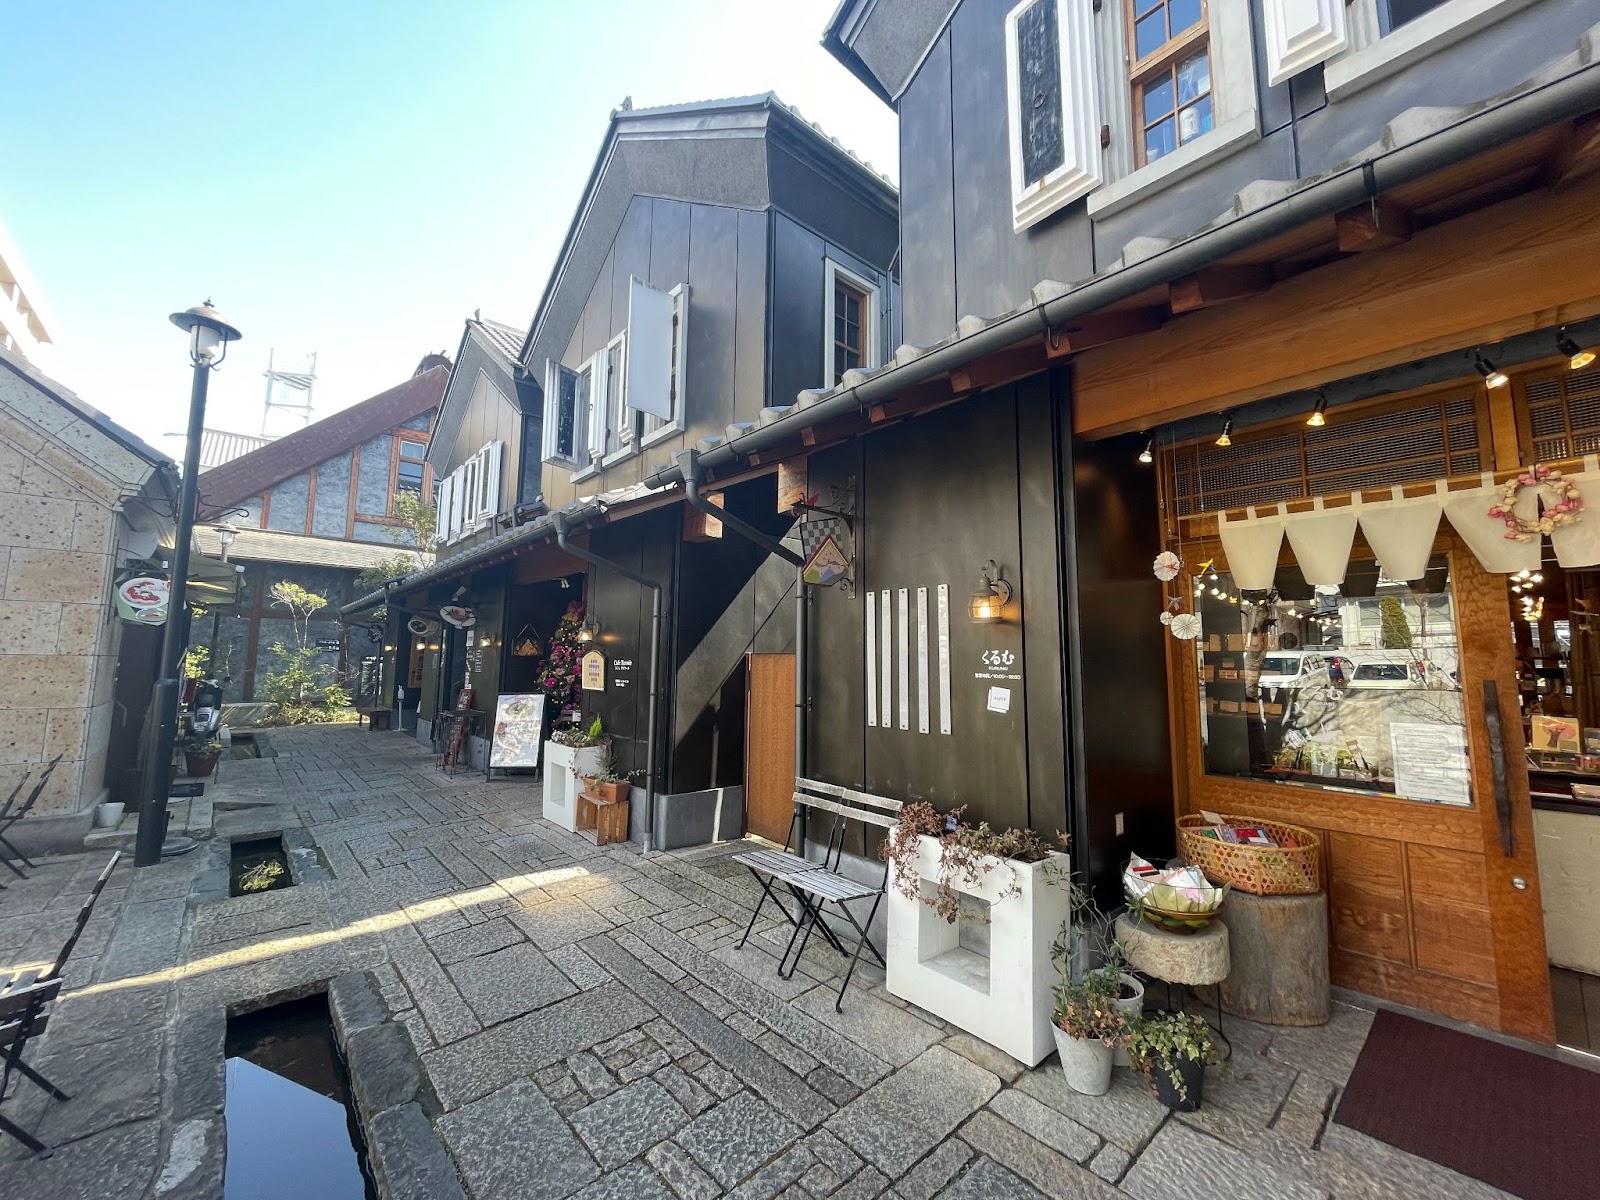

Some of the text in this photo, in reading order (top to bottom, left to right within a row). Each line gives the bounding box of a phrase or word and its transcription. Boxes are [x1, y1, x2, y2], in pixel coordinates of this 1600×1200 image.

[981, 649, 1015, 665] くるむ
[1299, 685, 1344, 700] くるむ
